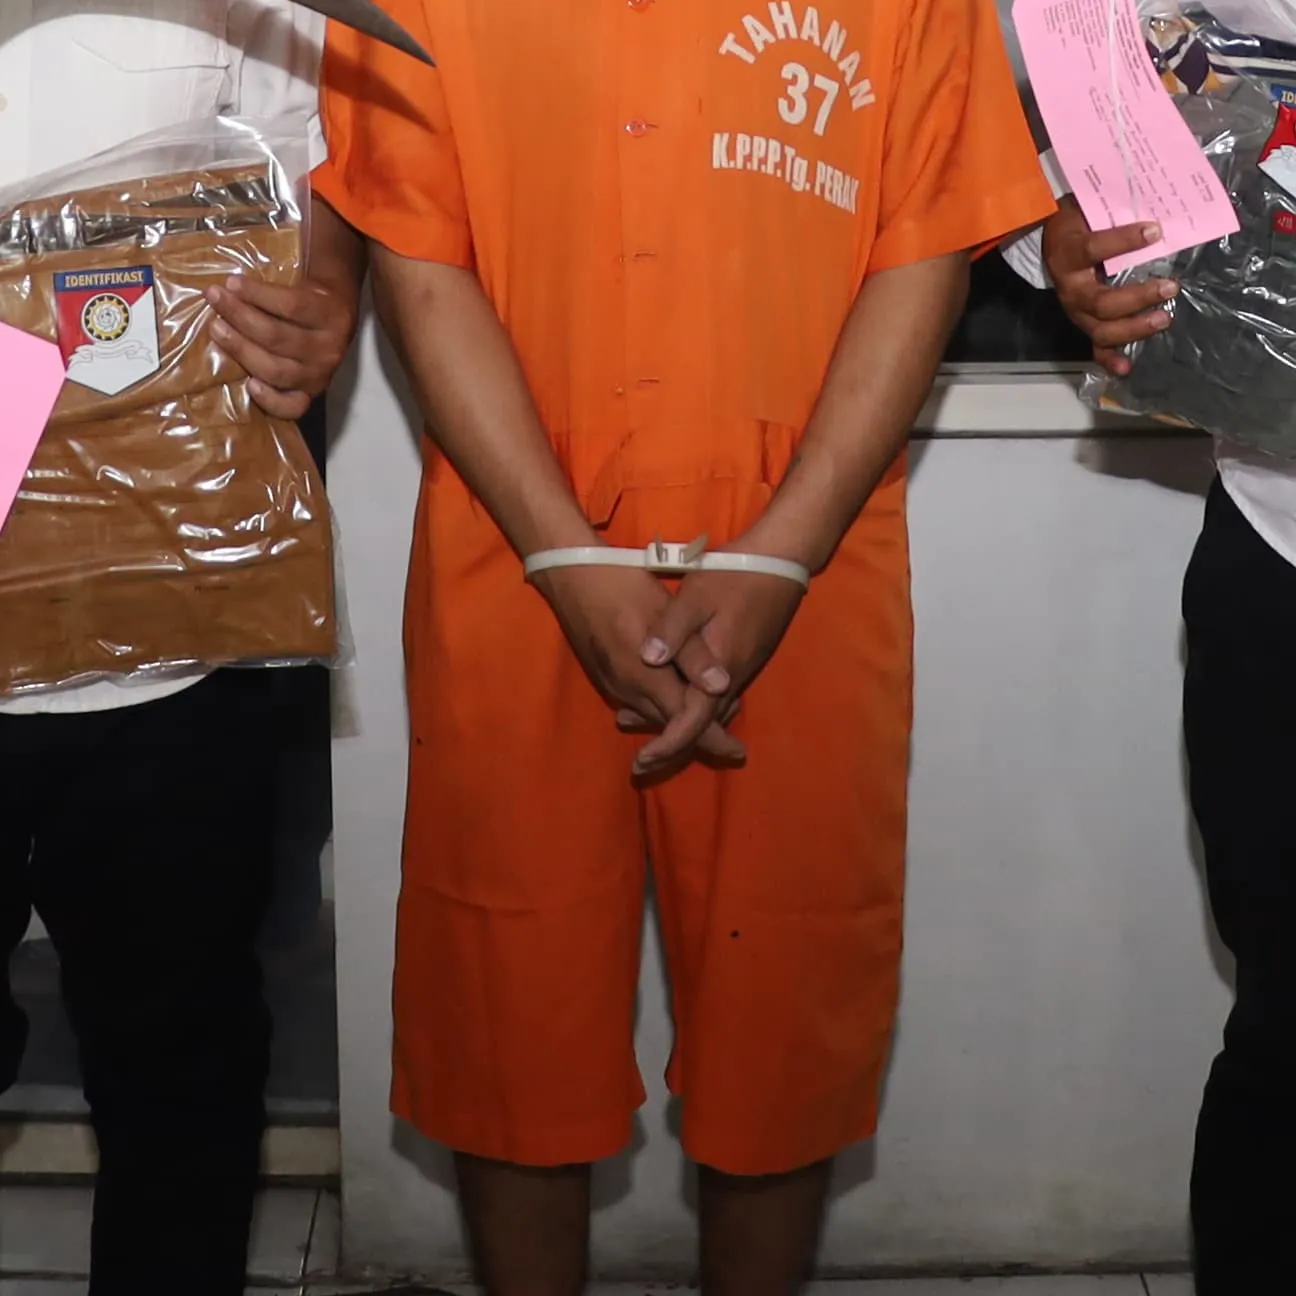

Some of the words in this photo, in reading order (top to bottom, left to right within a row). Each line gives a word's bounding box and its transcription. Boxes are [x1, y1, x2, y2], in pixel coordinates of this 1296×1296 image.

[718, 1, 876, 111] TAHANAN
[778, 62, 840, 136] 37
[815, 160, 860, 215] PERAK
[65, 270, 145, 288] IDENTIFIKASI
